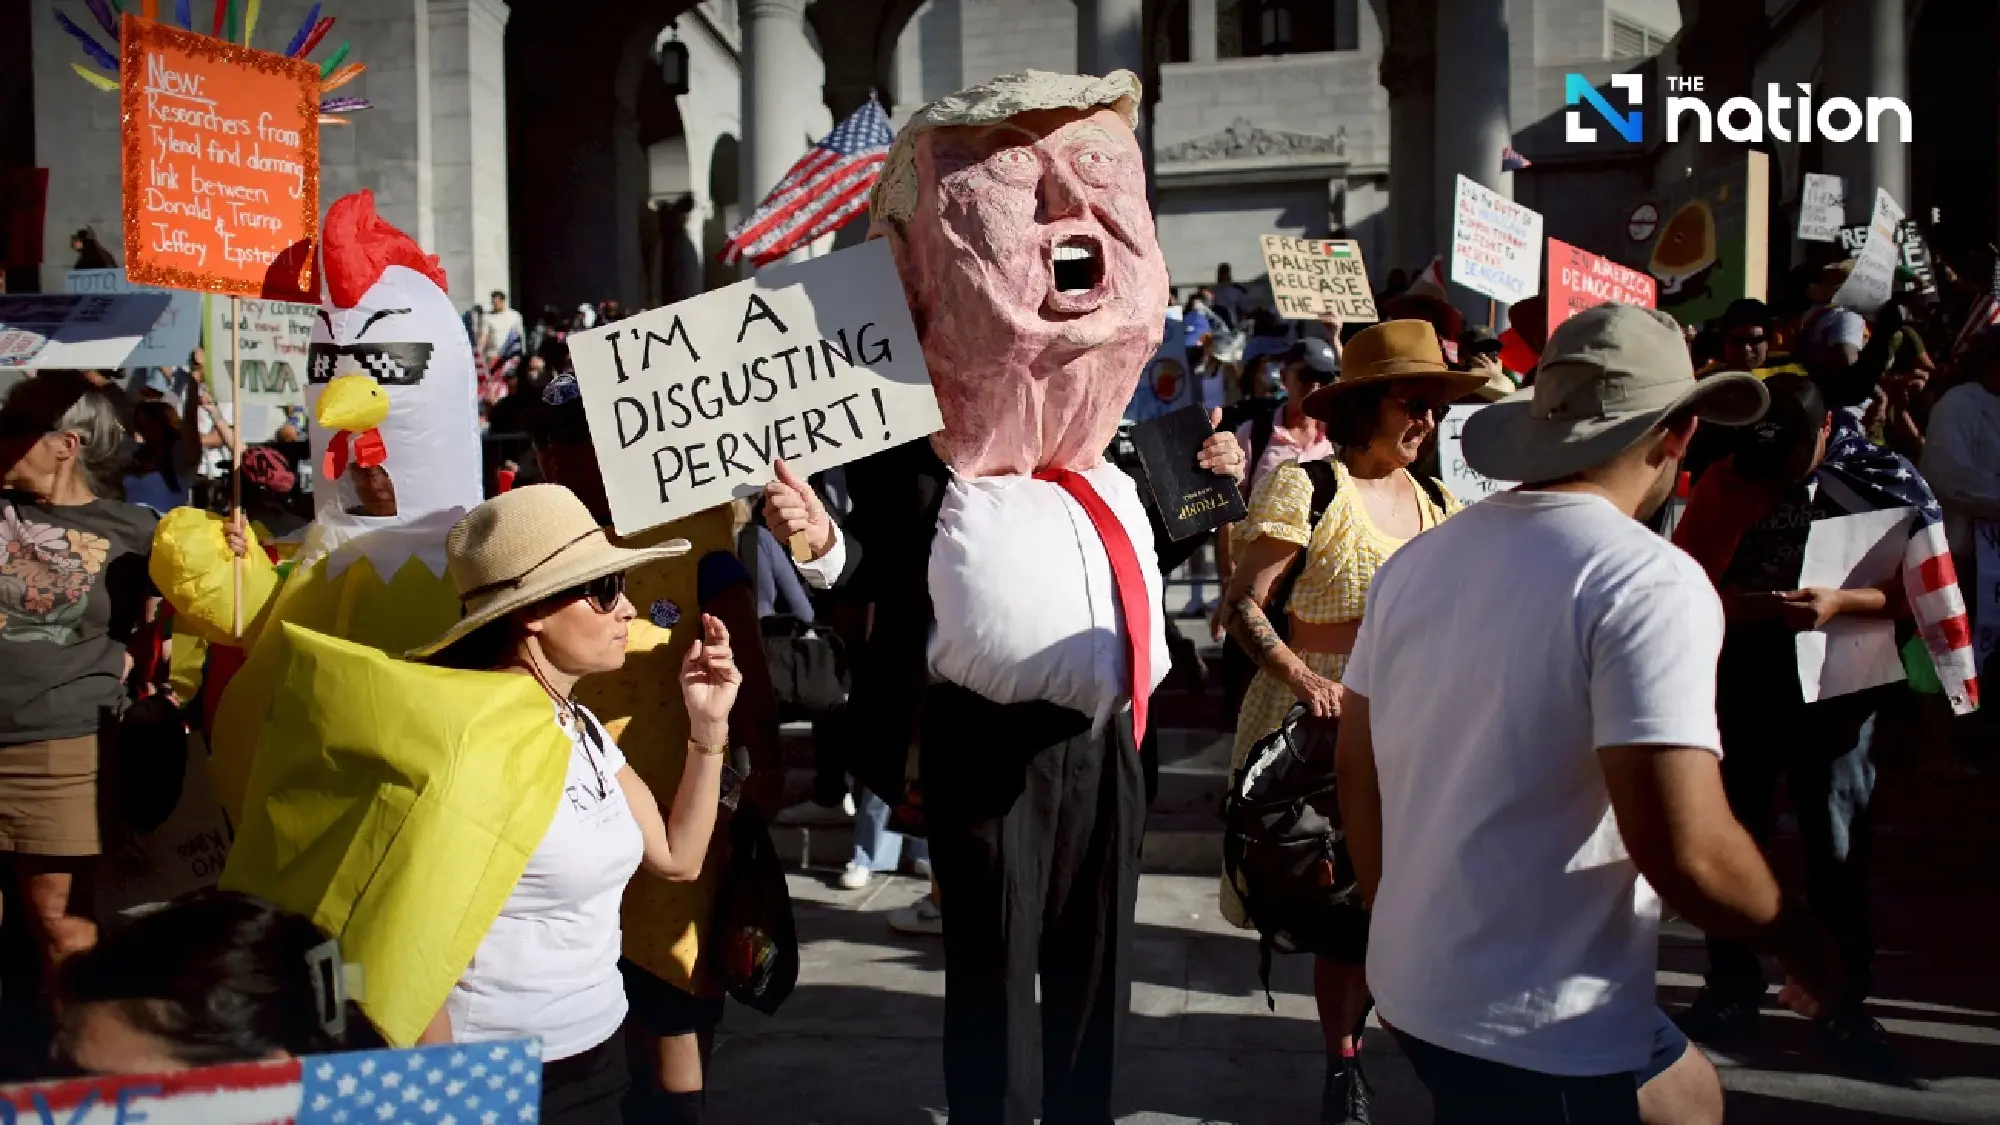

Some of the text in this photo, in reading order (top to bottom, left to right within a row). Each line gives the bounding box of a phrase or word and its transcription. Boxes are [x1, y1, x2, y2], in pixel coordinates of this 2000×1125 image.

[148, 92, 299, 147] Researchers from
[207, 140, 241, 167] find
[151, 159, 269, 203] link between
[145, 187, 283, 235] Donald Trump
[152, 223, 206, 266] Jeffery
[1265, 236, 1322, 255] FREE
[1268, 253, 1363, 276] PALESTINE
[1275, 273, 1362, 296] RELEASE
[1277, 294, 1378, 318] THE FILES
[605, 293, 789, 384] I'M A
[224, 359, 299, 393] VIVA
[613, 322, 893, 450] DISGUSTING
[652, 387, 891, 503] PERVERT!
[1178, 493, 1229, 520] TRUMP
